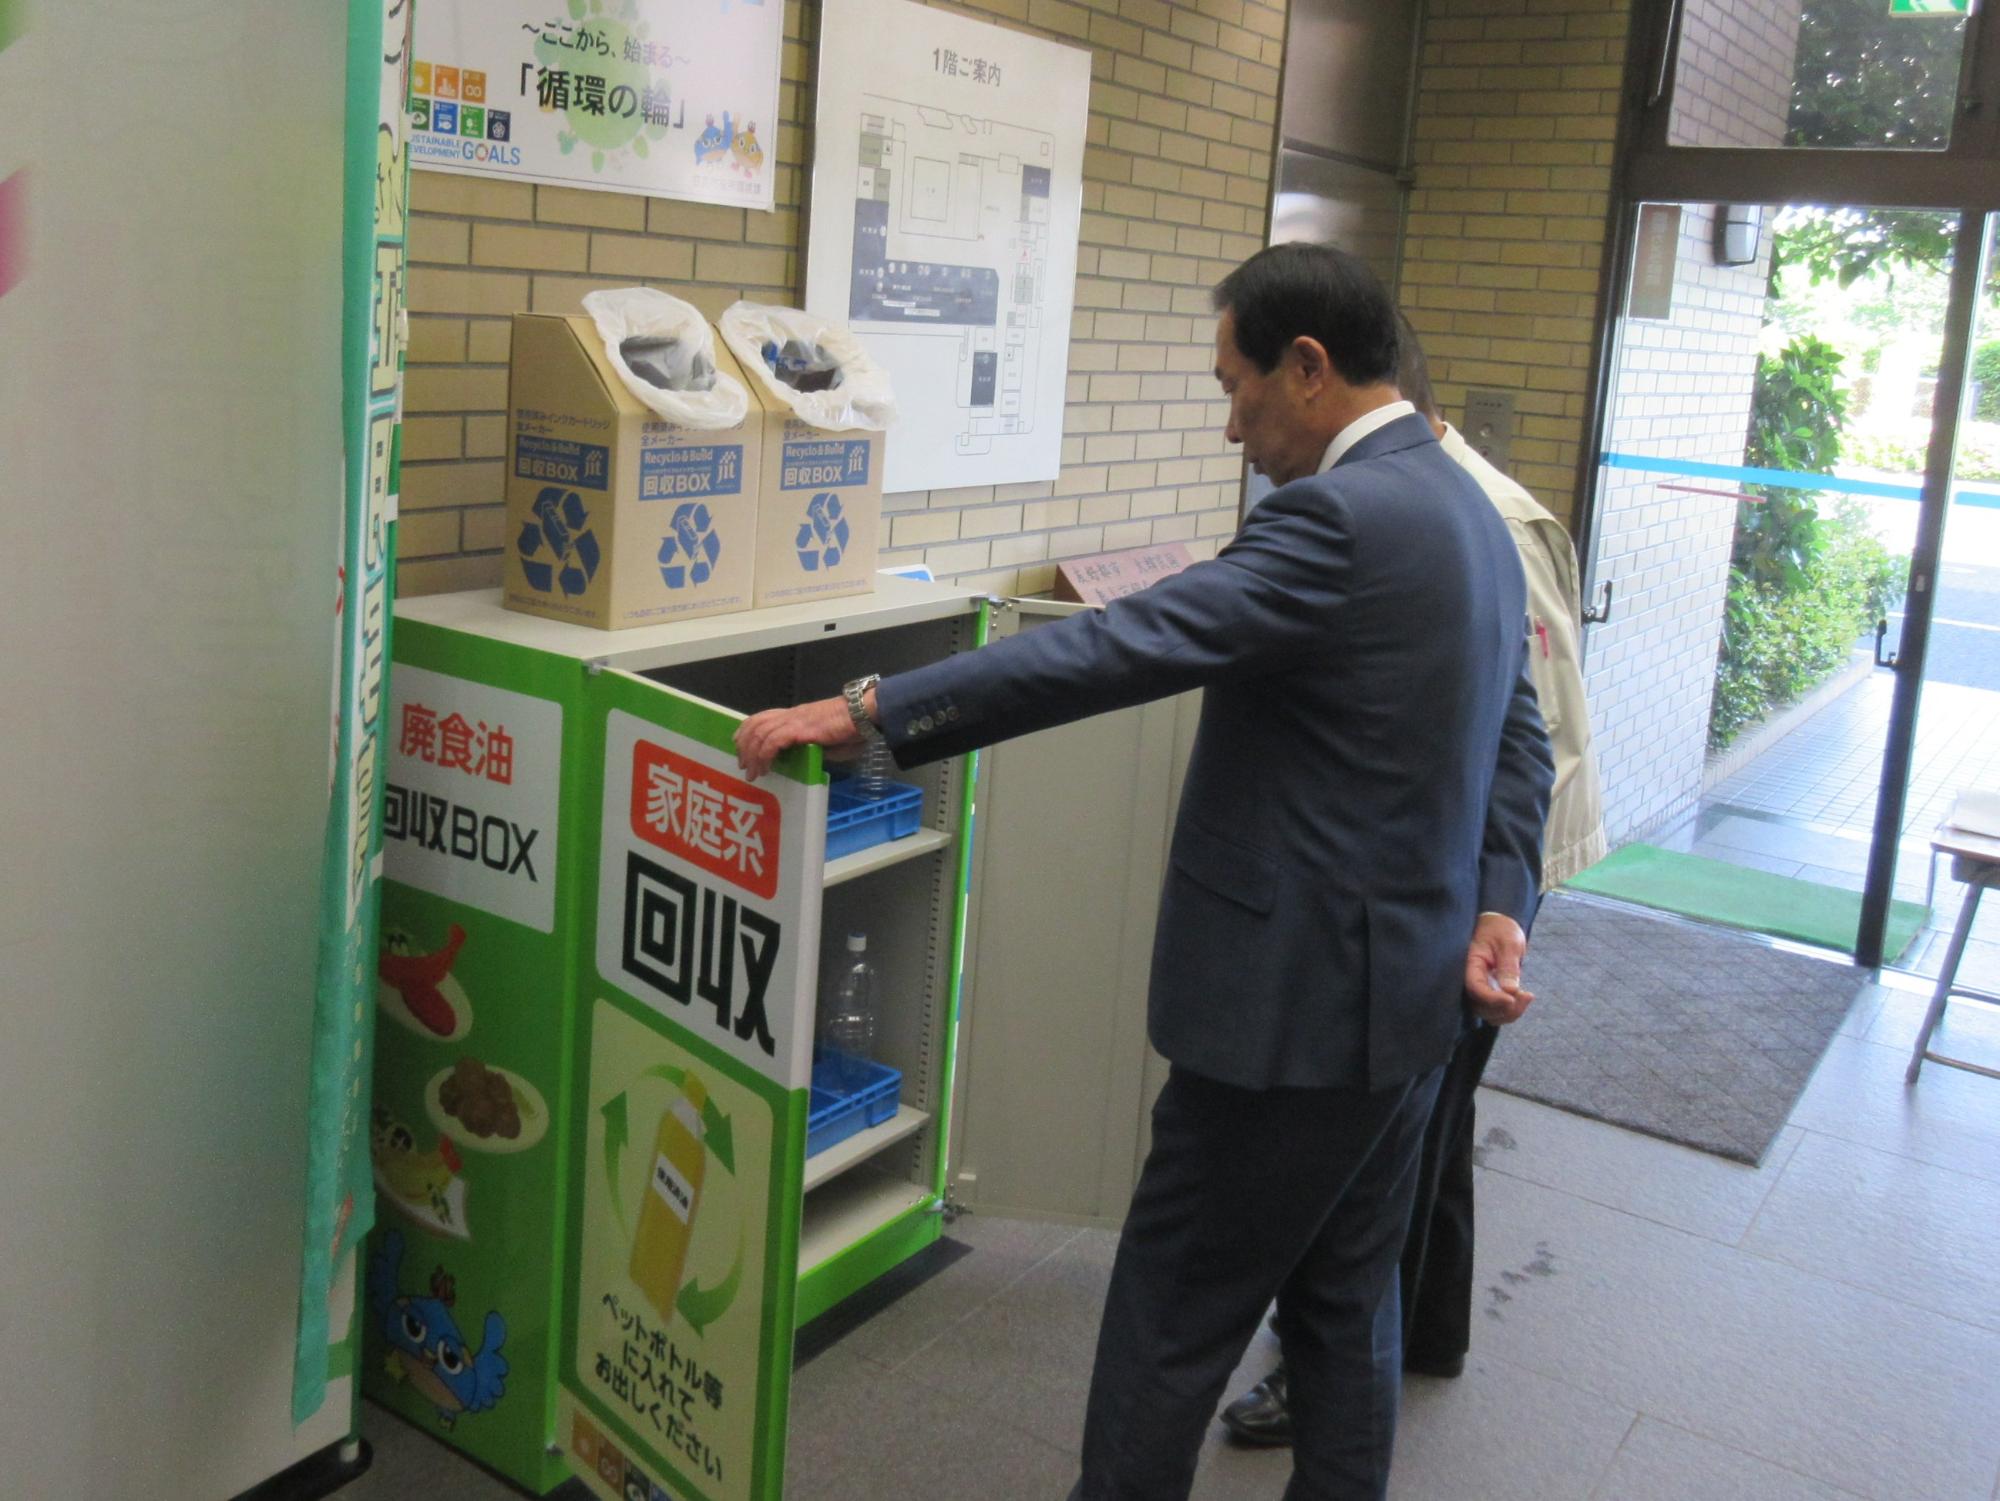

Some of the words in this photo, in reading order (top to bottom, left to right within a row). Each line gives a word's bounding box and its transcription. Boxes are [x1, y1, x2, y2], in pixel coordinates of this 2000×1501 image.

[520, 62, 685, 129] 「循環の輪」
[933, 48, 1001, 87] 1階ご案内
[462, 141, 521, 166] GOALS
[641, 434, 684, 447] 全メーカー
[784, 466, 843, 486] 回収BOX
[643, 473, 711, 496] 回収BOX
[400, 703, 514, 785] 廃食油
[384, 783, 539, 883] 回収BOX
[645, 762, 764, 877] 家庭系
[622, 849, 781, 1057] 回収
[602, 1292, 724, 1411] ペットボトル等
[623, 1339, 695, 1423] に入れて
[595, 1352, 723, 1482] お出しください
